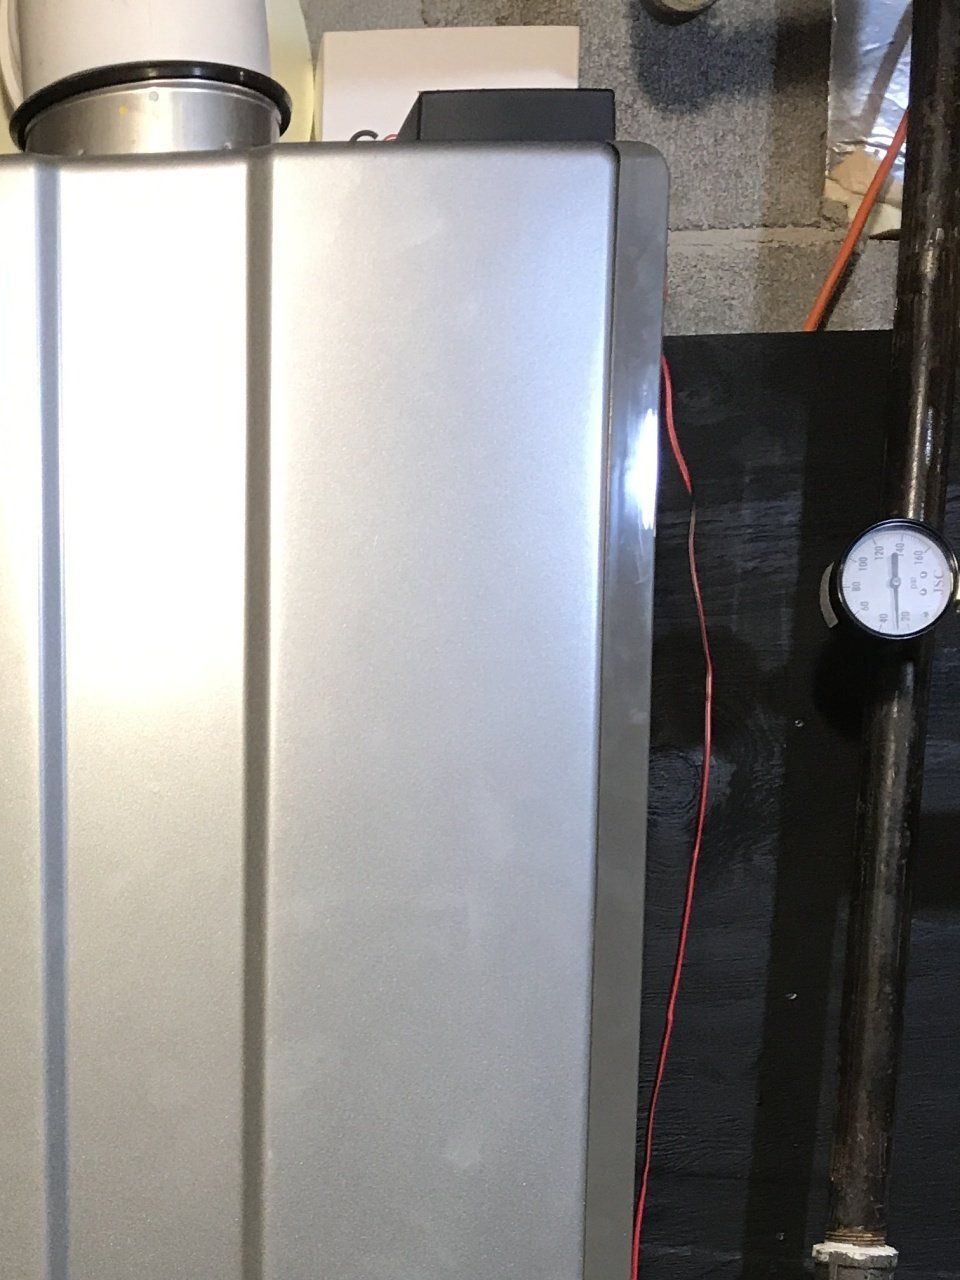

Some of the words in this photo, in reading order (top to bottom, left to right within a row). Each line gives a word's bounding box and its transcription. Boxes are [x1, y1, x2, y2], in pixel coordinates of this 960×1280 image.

[874, 545, 884, 560] 120
[914, 550, 924, 565] 160
[858, 556, 868, 571] 100
[851, 581, 861, 592] 80
[860, 601, 869, 611] 60
